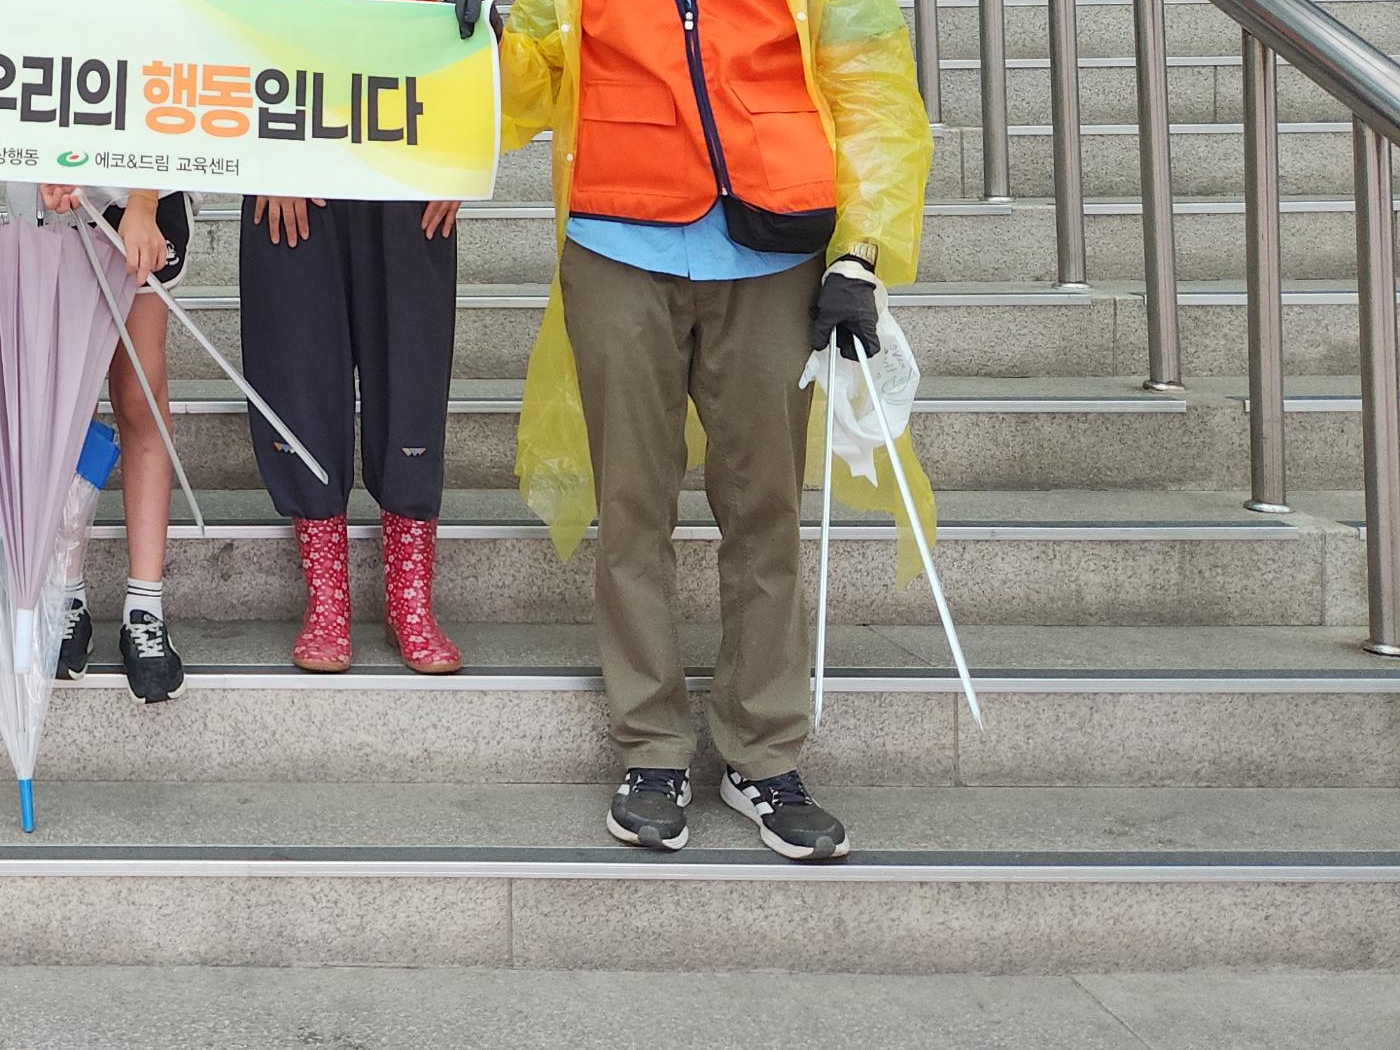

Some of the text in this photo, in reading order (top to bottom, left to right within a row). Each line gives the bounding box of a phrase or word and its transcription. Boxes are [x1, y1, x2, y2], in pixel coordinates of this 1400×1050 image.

[142, 60, 424, 146] 행동입니다
[95, 151, 240, 176] 에코&드림 교육센터
